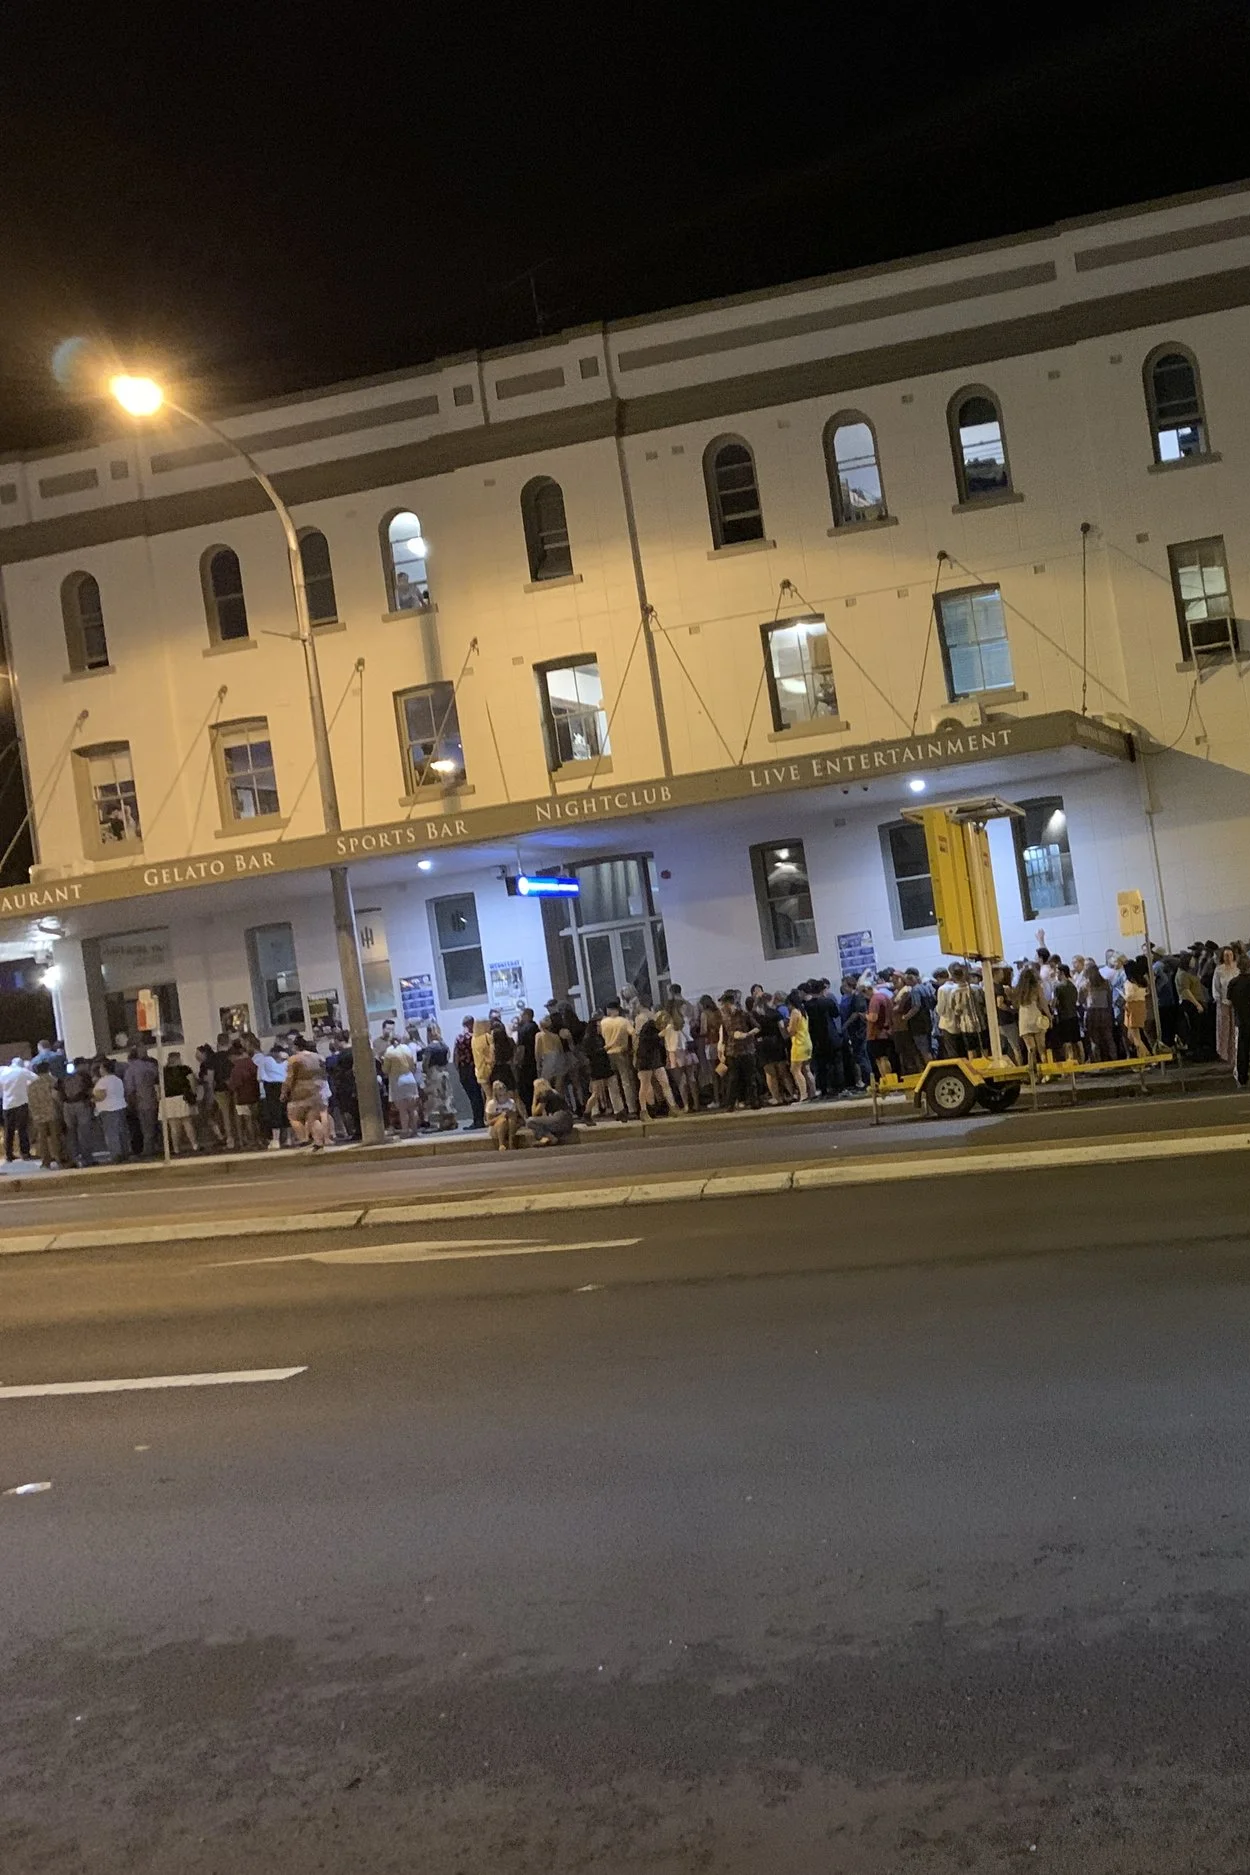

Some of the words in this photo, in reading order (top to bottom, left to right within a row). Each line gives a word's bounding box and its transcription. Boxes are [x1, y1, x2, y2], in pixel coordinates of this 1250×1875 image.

[750, 764, 801, 787] LIVE
[812, 729, 1012, 777] ENTERTAINMENT
[536, 785, 672, 822] NIGHTCLUB
[337, 827, 415, 856] SPORTS
[427, 819, 469, 840] BAR
[144, 859, 225, 887] GELATO
[235, 852, 275, 873] BAR
